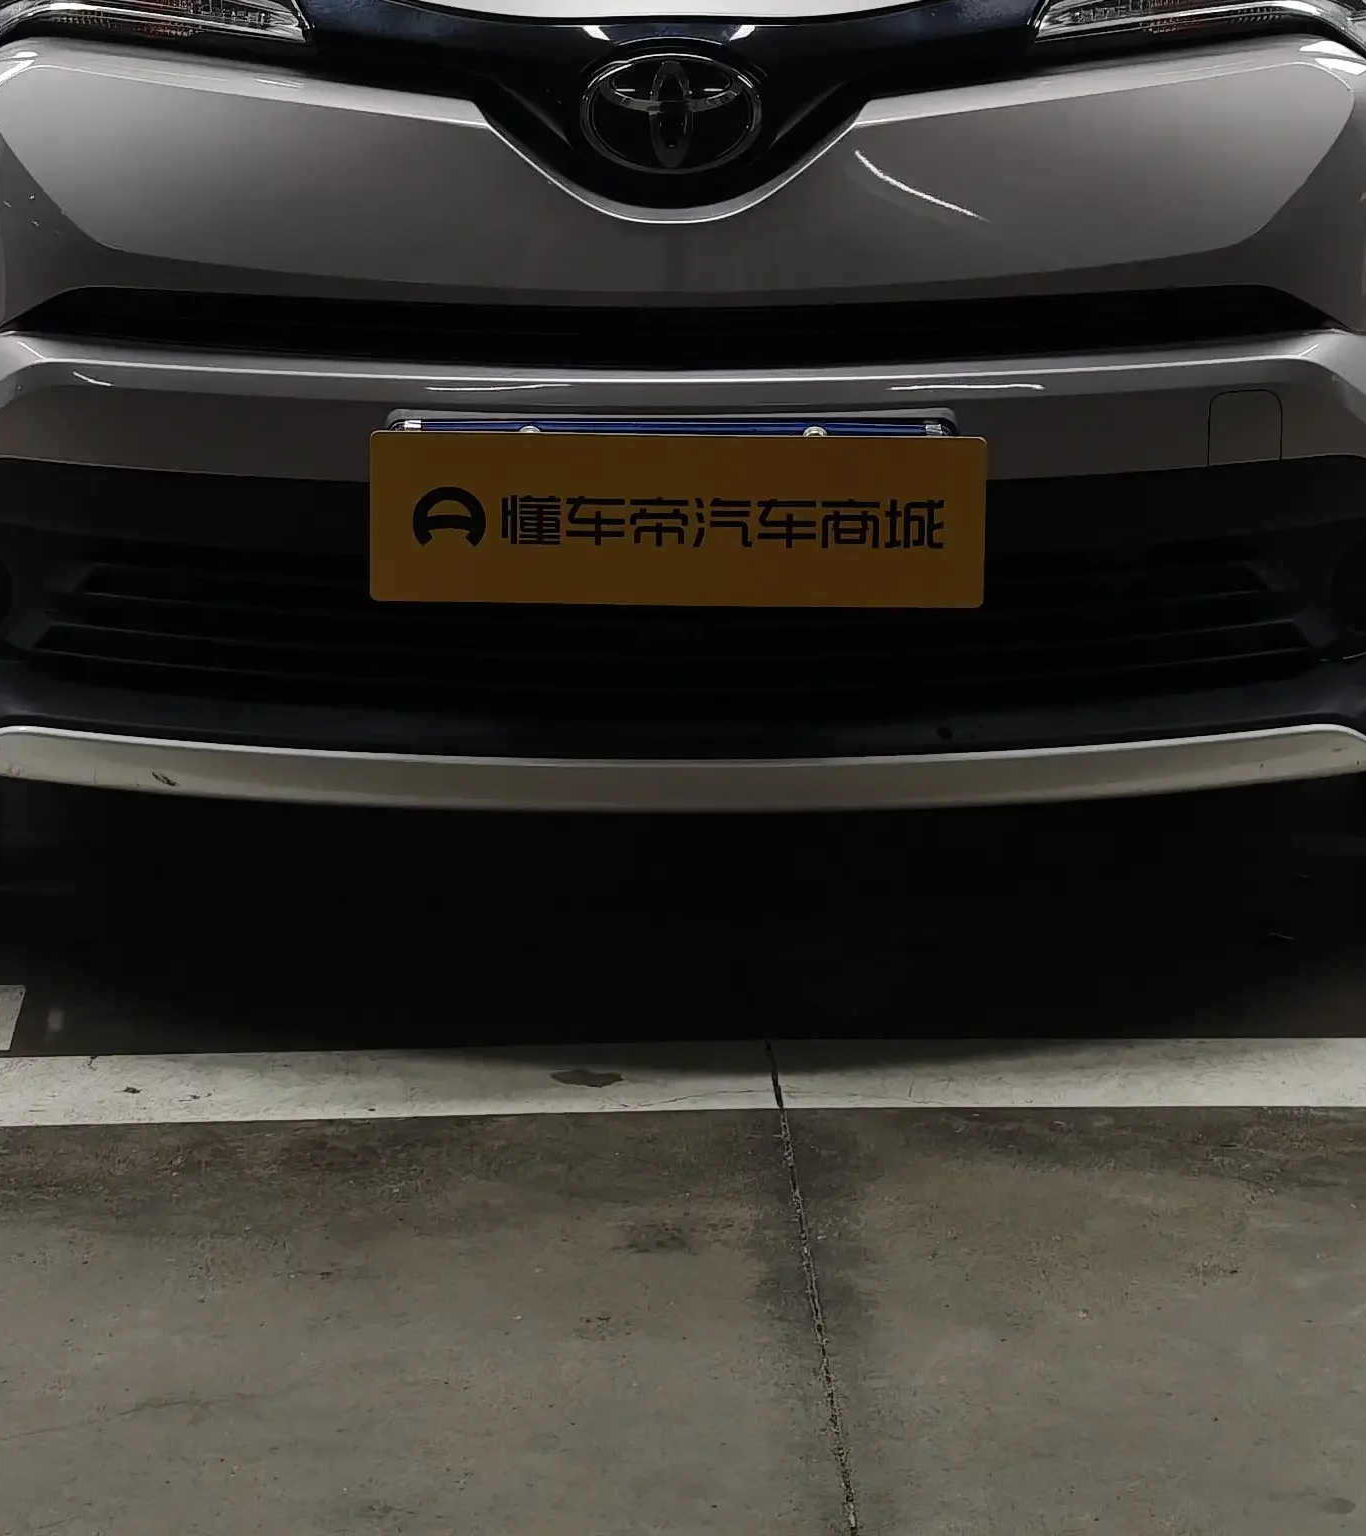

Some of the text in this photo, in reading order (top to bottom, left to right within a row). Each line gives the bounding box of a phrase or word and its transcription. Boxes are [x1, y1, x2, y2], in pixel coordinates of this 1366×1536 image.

[500, 494, 944, 550] 懂车帝汽车商城
